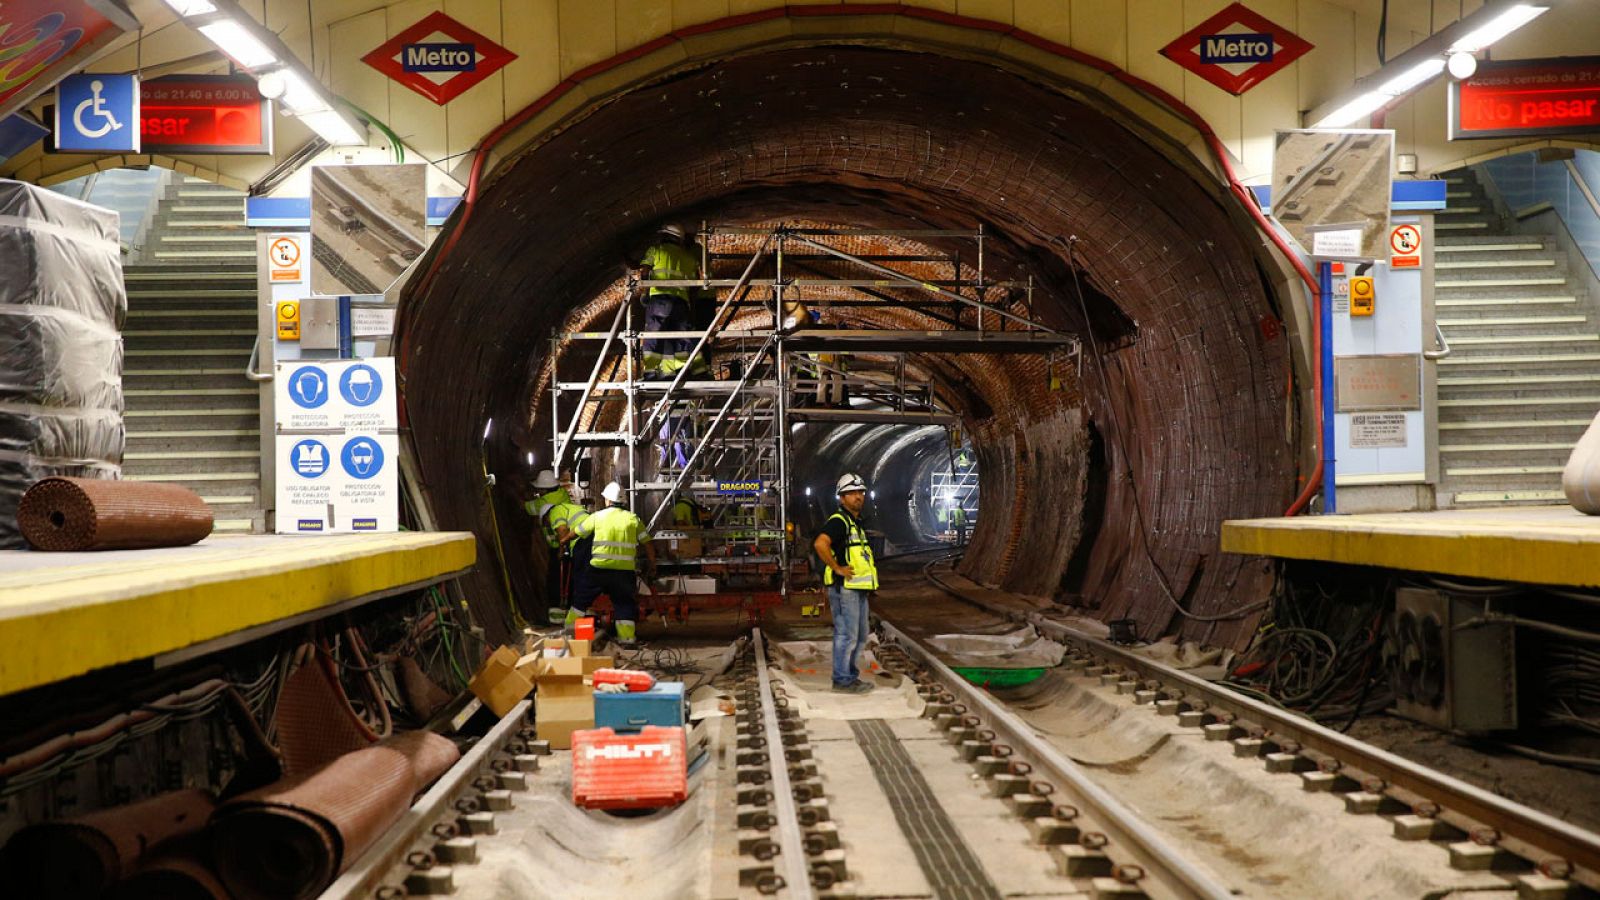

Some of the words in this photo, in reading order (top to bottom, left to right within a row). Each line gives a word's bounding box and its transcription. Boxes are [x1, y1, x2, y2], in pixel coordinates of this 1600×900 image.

[407, 47, 471, 66] Metro
[1206, 39, 1269, 58] Metro
[171, 89, 202, 99] 21.40
[215, 89, 240, 99] 6.00
[1478, 99, 1513, 120] No
[1521, 99, 1597, 124] pasar
[585, 743, 671, 760] HILTI
